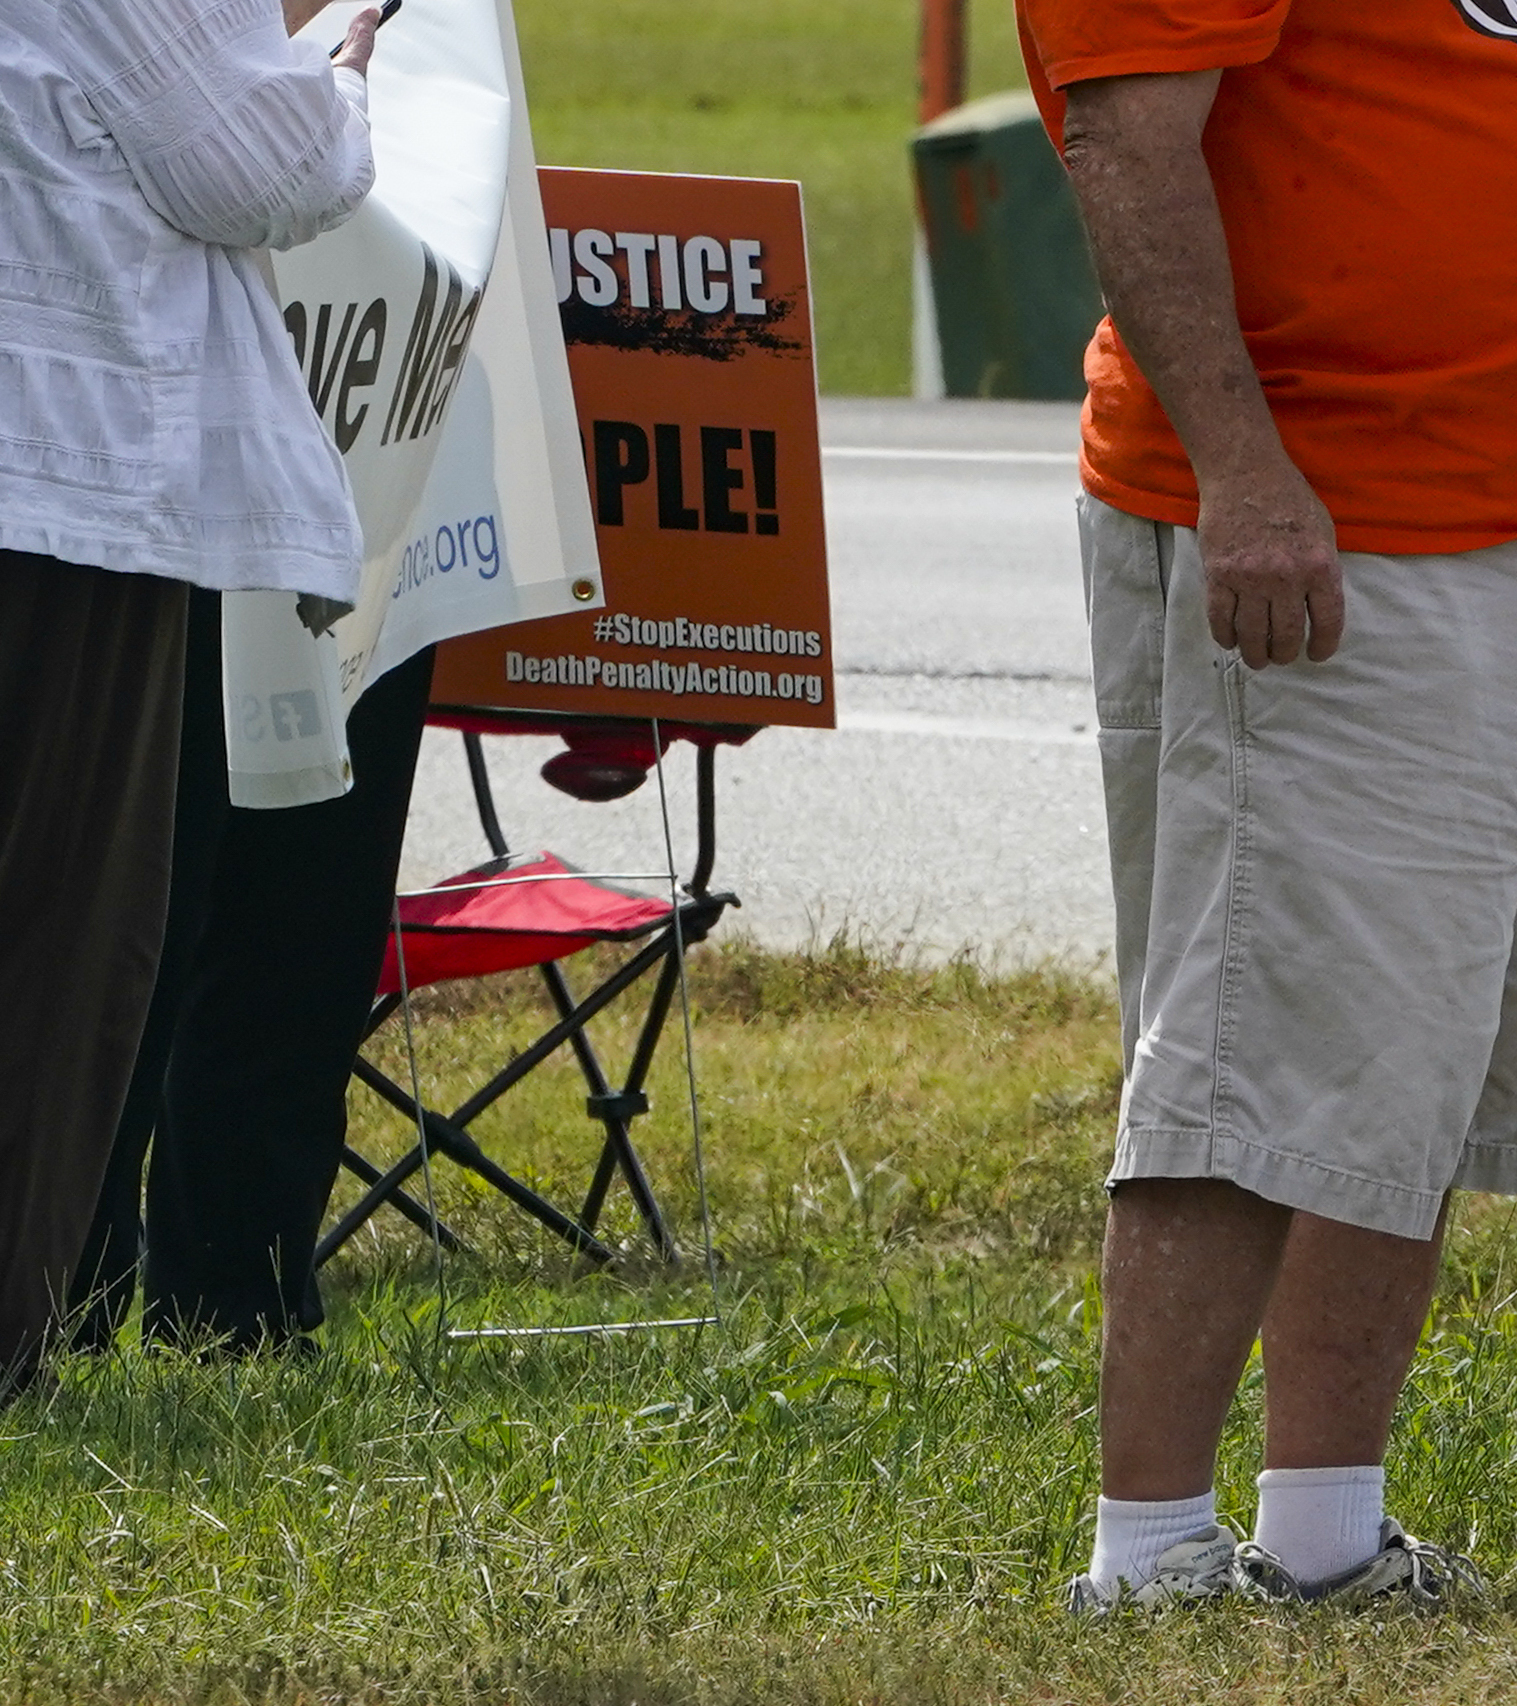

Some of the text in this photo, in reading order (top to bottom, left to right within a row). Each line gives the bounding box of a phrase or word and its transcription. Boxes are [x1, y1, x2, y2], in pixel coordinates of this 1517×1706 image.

[581, 419, 779, 536] PLE!
[593, 612, 822, 658] #StopExecutions
[505, 650, 823, 704] DeathPenaltyAction.org
